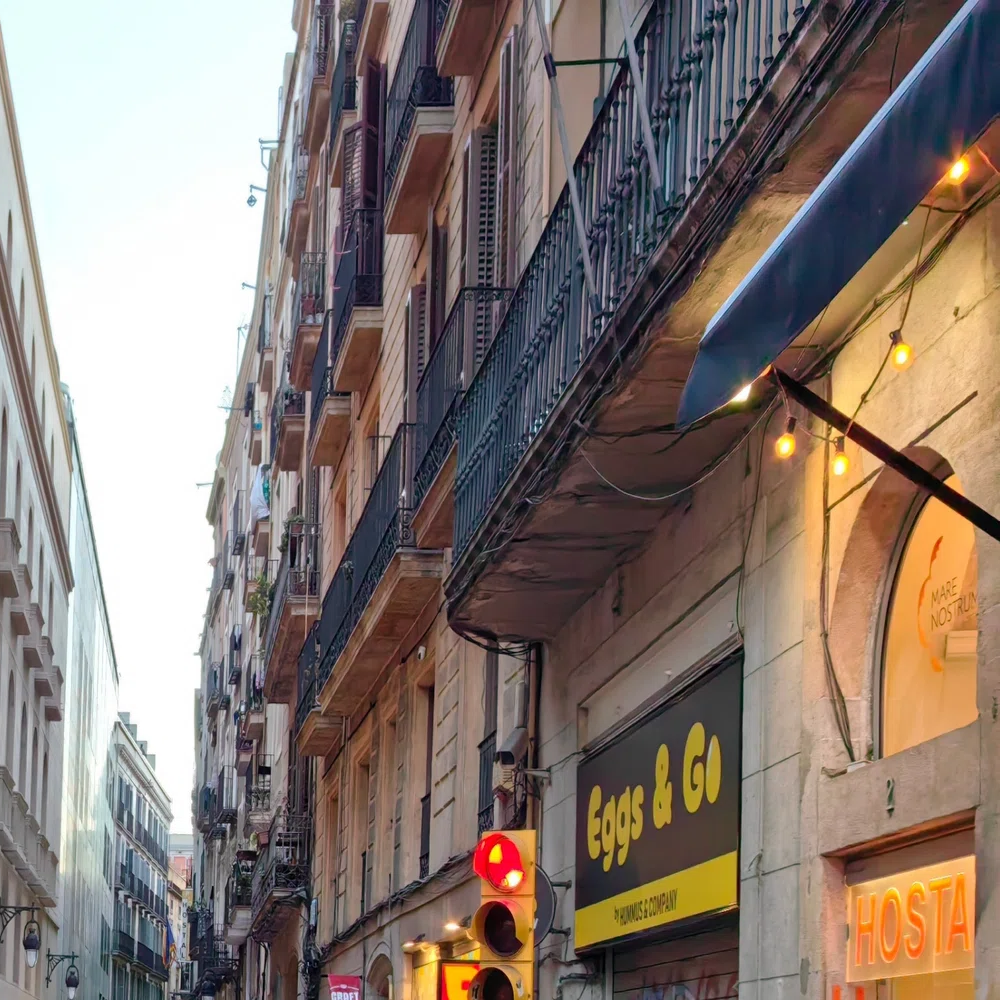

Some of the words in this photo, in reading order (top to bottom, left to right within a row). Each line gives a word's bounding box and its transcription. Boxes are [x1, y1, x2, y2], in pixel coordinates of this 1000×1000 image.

[931, 576, 958, 608] MARE
[587, 785, 645, 873] Eggs
[653, 743, 673, 829] &
[620, 900, 643, 927] HUMMUS
[649, 887, 678, 917] COMPANY
